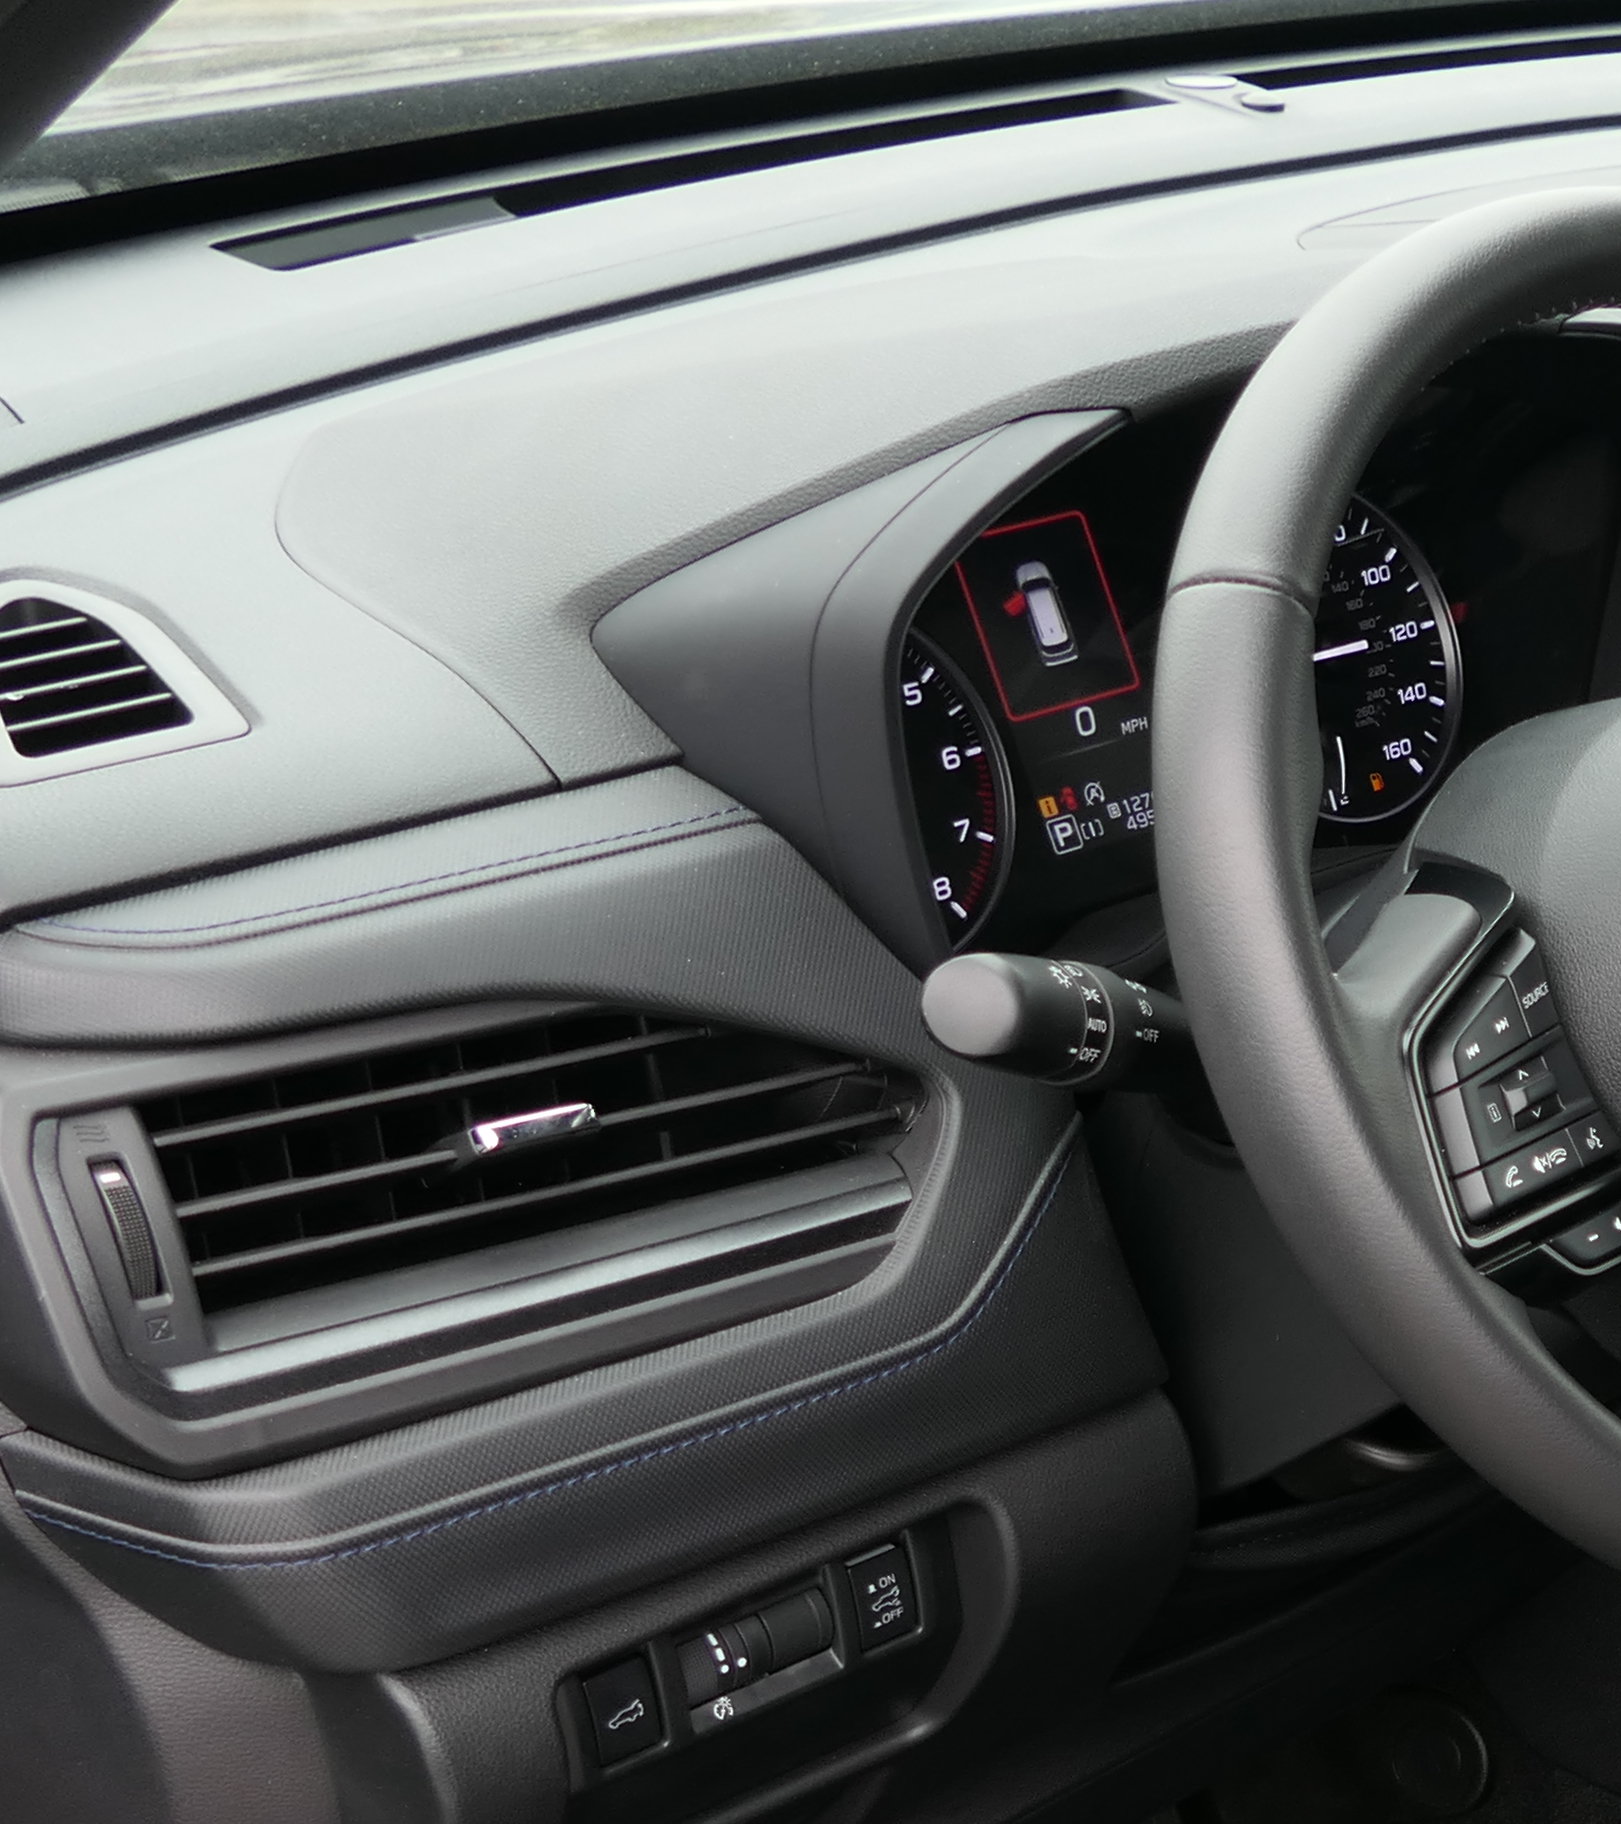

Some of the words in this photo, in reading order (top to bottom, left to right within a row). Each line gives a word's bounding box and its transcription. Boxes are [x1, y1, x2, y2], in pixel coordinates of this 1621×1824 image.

[1360, 564, 1391, 587] 100
[1389, 621, 1418, 642] 120
[902, 682, 922, 706] 5
[1397, 682, 1427, 704] 140
[1075, 705, 1096, 737] 0
[1120, 716, 1148, 736] MPH
[941, 746, 961, 770] 6
[1382, 738, 1412, 760] 160
[953, 818, 970, 843] 7
[932, 876, 952, 901] 8
[1521, 981, 1550, 1010] SOURCE
[1087, 1017, 1108, 1034] AUTO
[1143, 1028, 1160, 1043] OFF
[1079, 1047, 1102, 1063] OFF
[878, 1573, 896, 1588] ON
[882, 1606, 904, 1624] OFF
